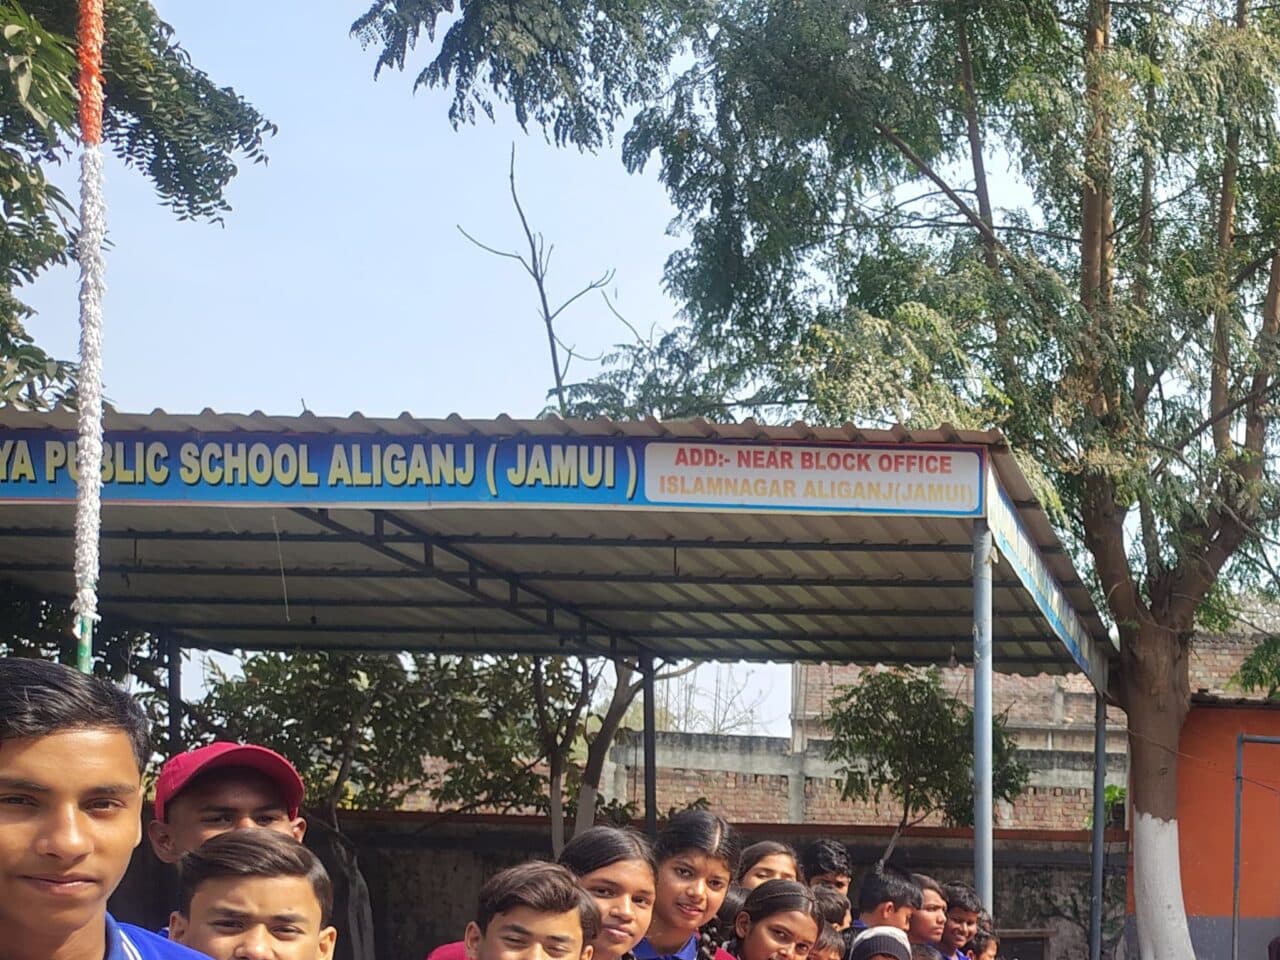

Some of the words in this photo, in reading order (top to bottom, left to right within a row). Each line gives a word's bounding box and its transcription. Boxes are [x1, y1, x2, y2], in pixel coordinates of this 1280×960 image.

[179, 441, 318, 487] SCHOOL
[328, 443, 474, 487] ALIGANJ
[506, 443, 615, 488] JAMUI
[675, 447, 730, 467] ADD:-
[737, 449, 793, 470] NEAR
[801, 451, 872, 472] BLOCK
[878, 453, 952, 474] OFFICE
[658, 475, 797, 498] ISLAMNAGAR
